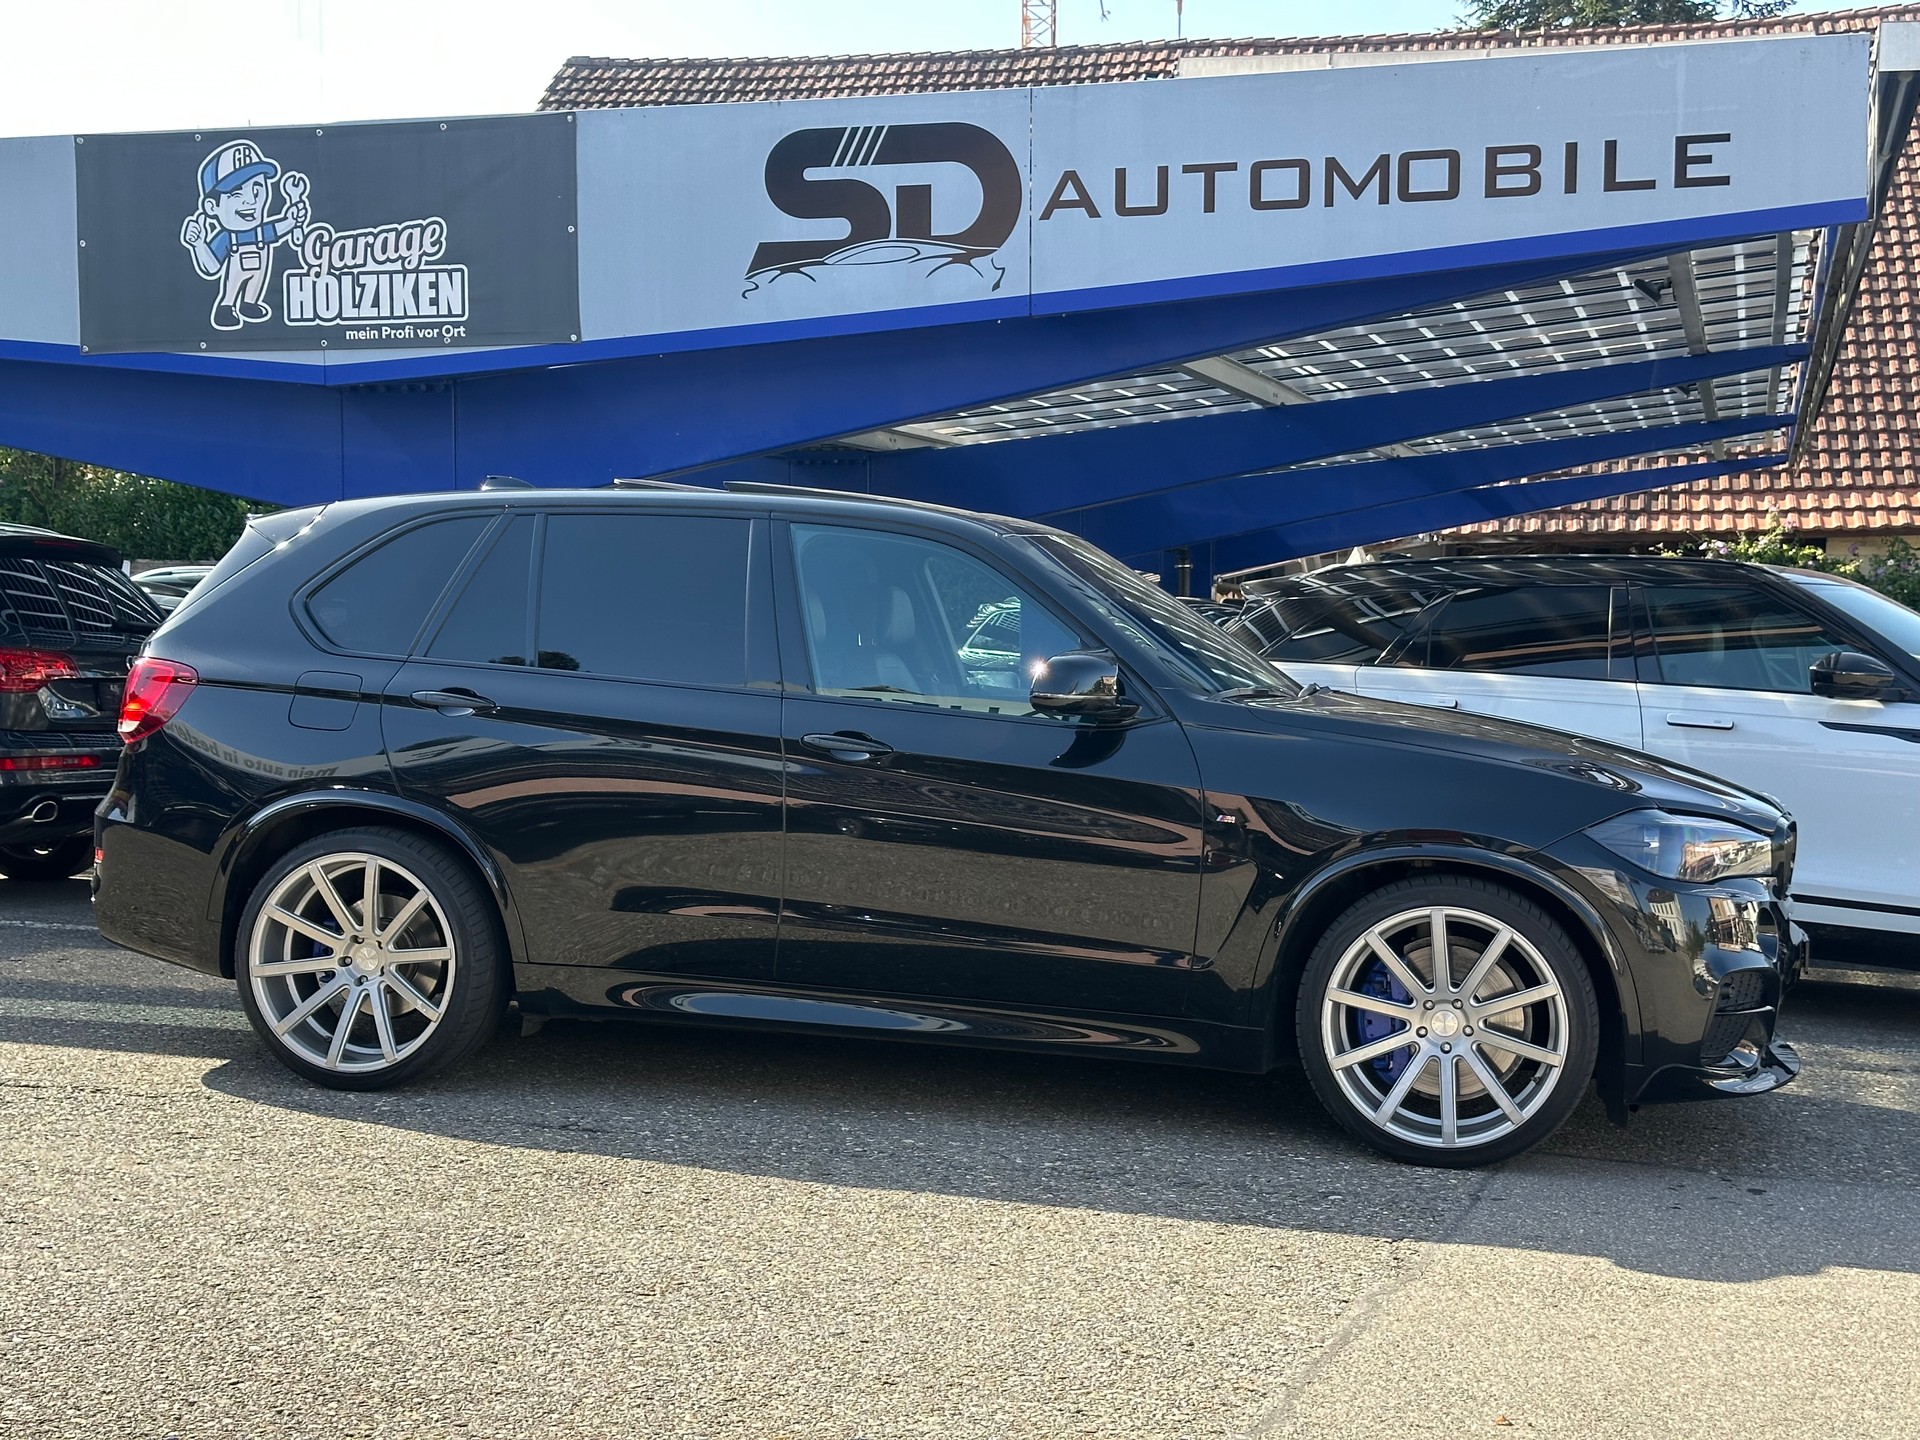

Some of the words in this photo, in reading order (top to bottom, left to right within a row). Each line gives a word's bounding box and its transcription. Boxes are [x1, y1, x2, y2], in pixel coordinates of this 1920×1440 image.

[745, 122, 1022, 281] SD
[1038, 133, 1731, 221] AUTOMOBILE
[303, 222, 443, 283] Garage
[288, 270, 464, 320] HOLZIKEN
[345, 327, 379, 340] mein
[381, 325, 414, 339] Profi
[416, 327, 440, 338] vor
[441, 324, 467, 339] Ort
